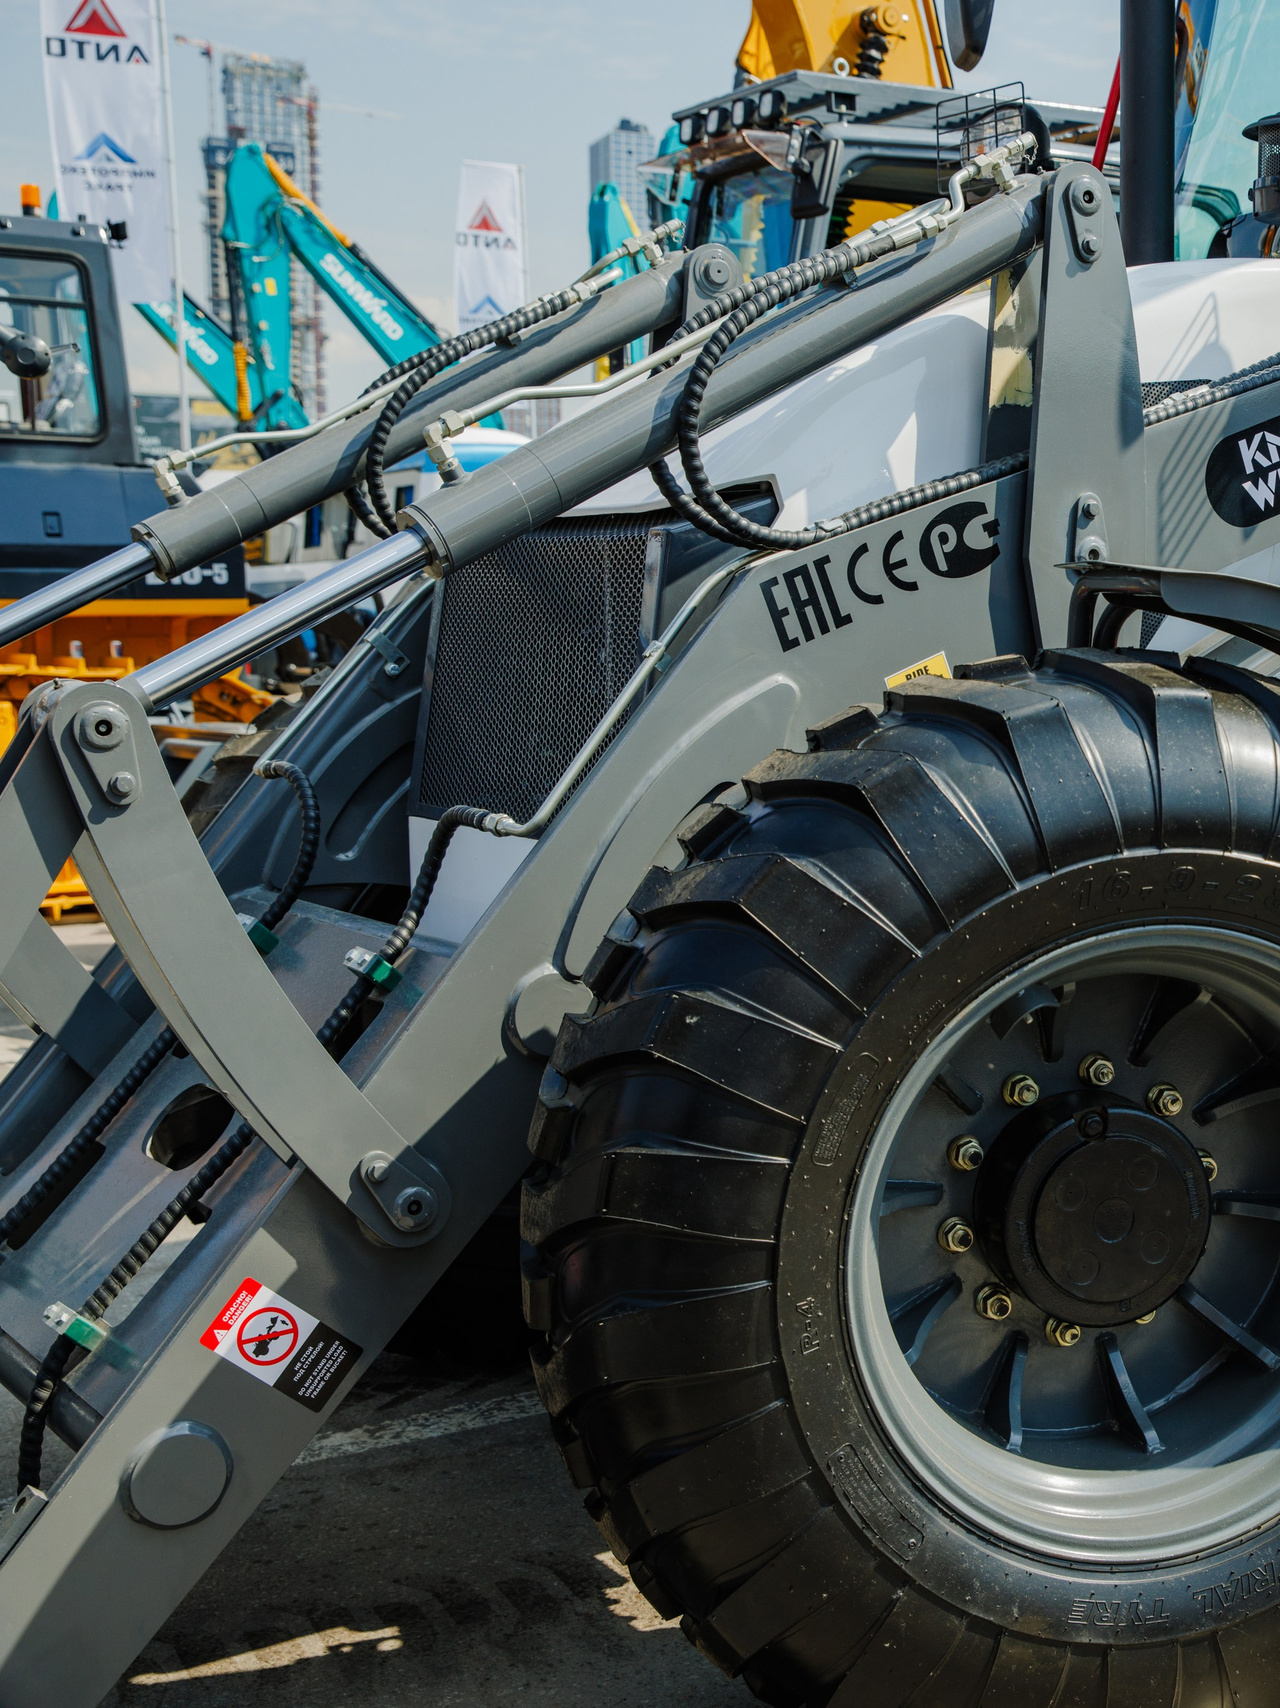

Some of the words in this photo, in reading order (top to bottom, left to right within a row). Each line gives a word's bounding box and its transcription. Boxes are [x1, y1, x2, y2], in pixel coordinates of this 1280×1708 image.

[221, 1290, 248, 1323] ОПАСНО!
[227, 1294, 253, 1326] DANGER!
[796, 1296, 821, 1356] R-4
[293, 1362, 302, 1371] НЕ
[300, 1346, 314, 1363] СТОЙ
[293, 1368, 306, 1383] ПОД
[302, 1341, 325, 1370] СТРЕЛОЙ!
[298, 1387, 306, 1396] DO
[304, 1376, 315, 1388] NOT
[312, 1358, 327, 1377] STAND
[325, 1340, 340, 1359] UNDER
[304, 1359, 334, 1398] UNSUPPORTED
[331, 1345, 344, 1360] LOAD
[310, 1380, 326, 1399] FRAME
[323, 1372, 332, 1381] OR
[329, 1350, 348, 1373] BUCKET!
[1066, 1597, 1172, 1627] TYRE
